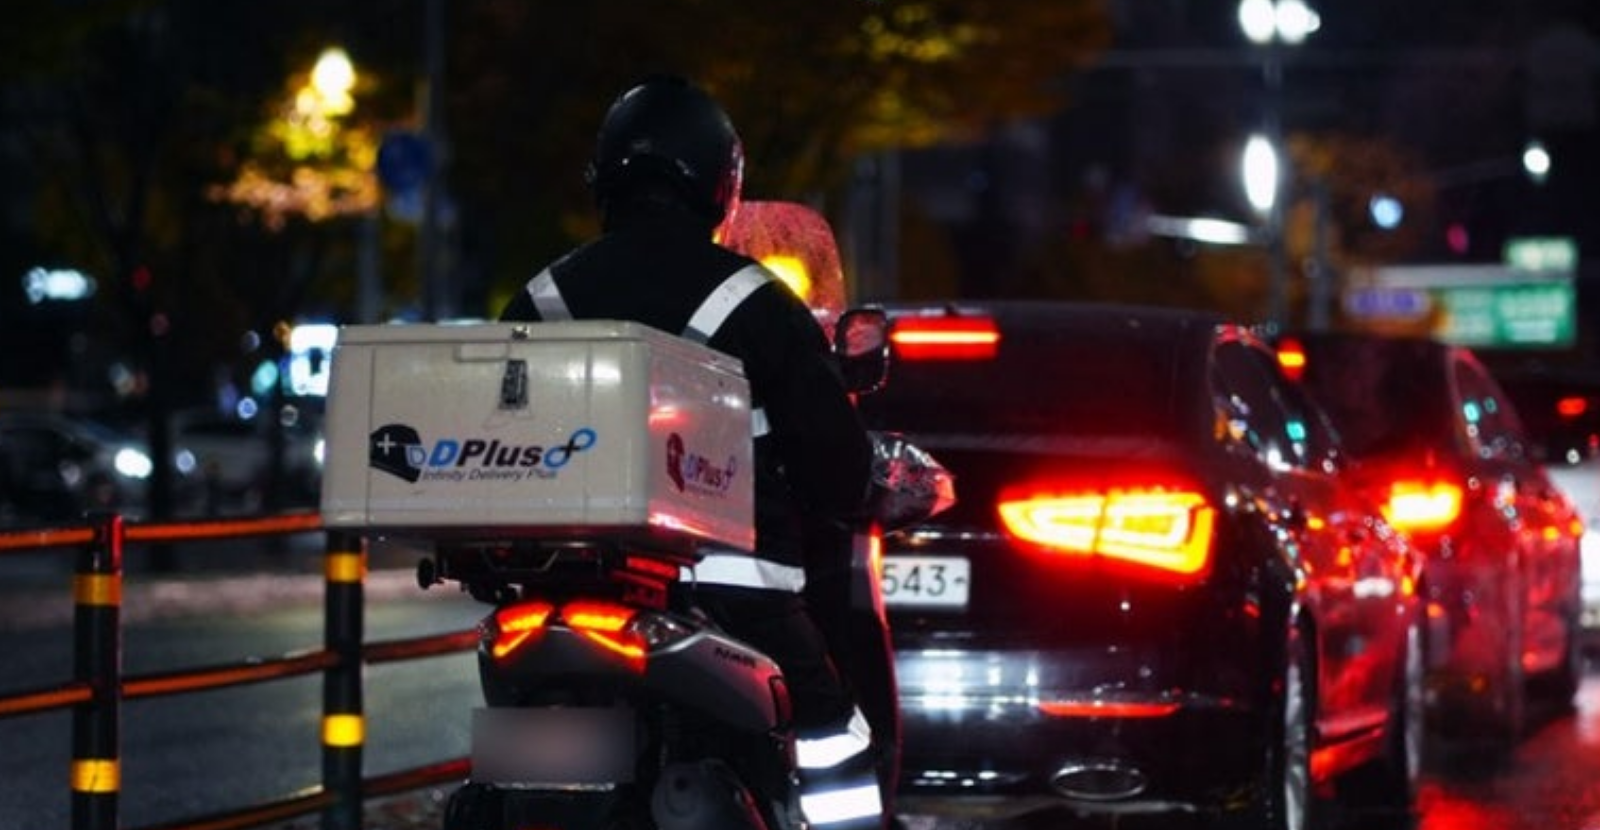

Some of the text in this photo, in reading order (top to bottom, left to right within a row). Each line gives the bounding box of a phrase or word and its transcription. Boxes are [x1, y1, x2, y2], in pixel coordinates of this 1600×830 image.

[429, 439, 543, 467] DPlus
[422, 467, 558, 482] Infinity Delivery Plus
